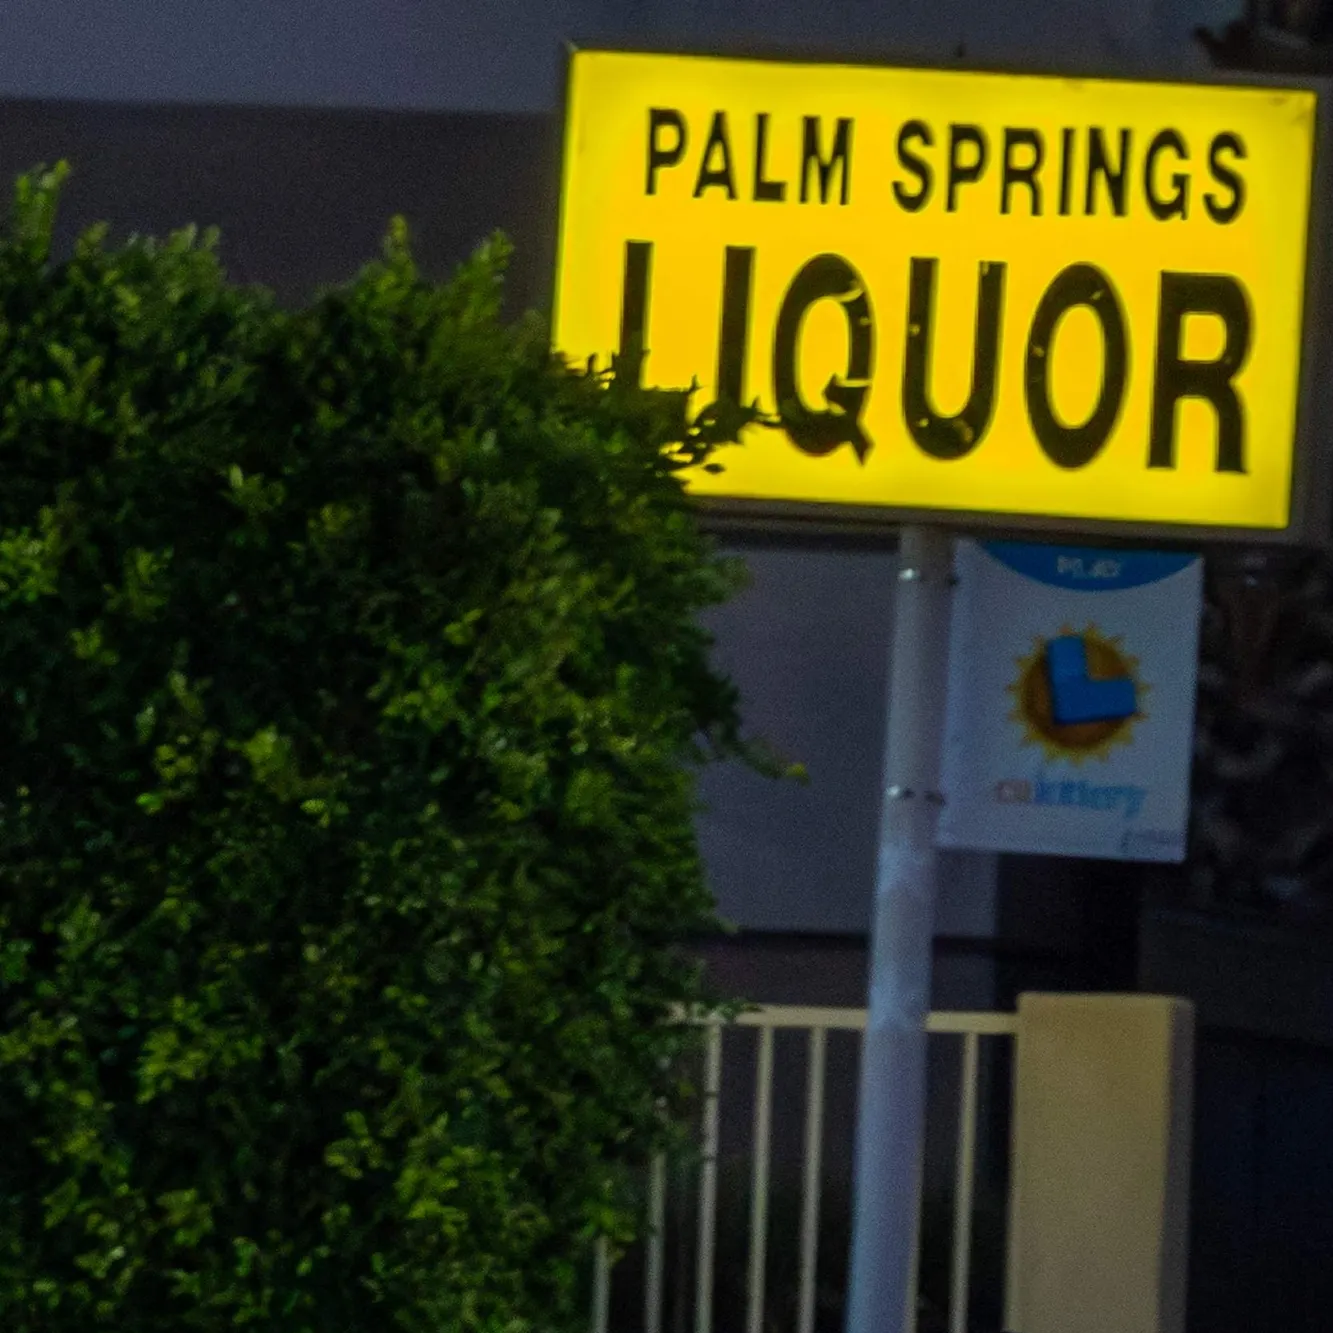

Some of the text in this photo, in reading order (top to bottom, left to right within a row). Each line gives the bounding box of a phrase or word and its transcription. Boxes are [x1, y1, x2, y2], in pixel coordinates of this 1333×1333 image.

[645, 107, 1246, 225] PALM SPRINGS
[618, 240, 1253, 475] LIQUOR
